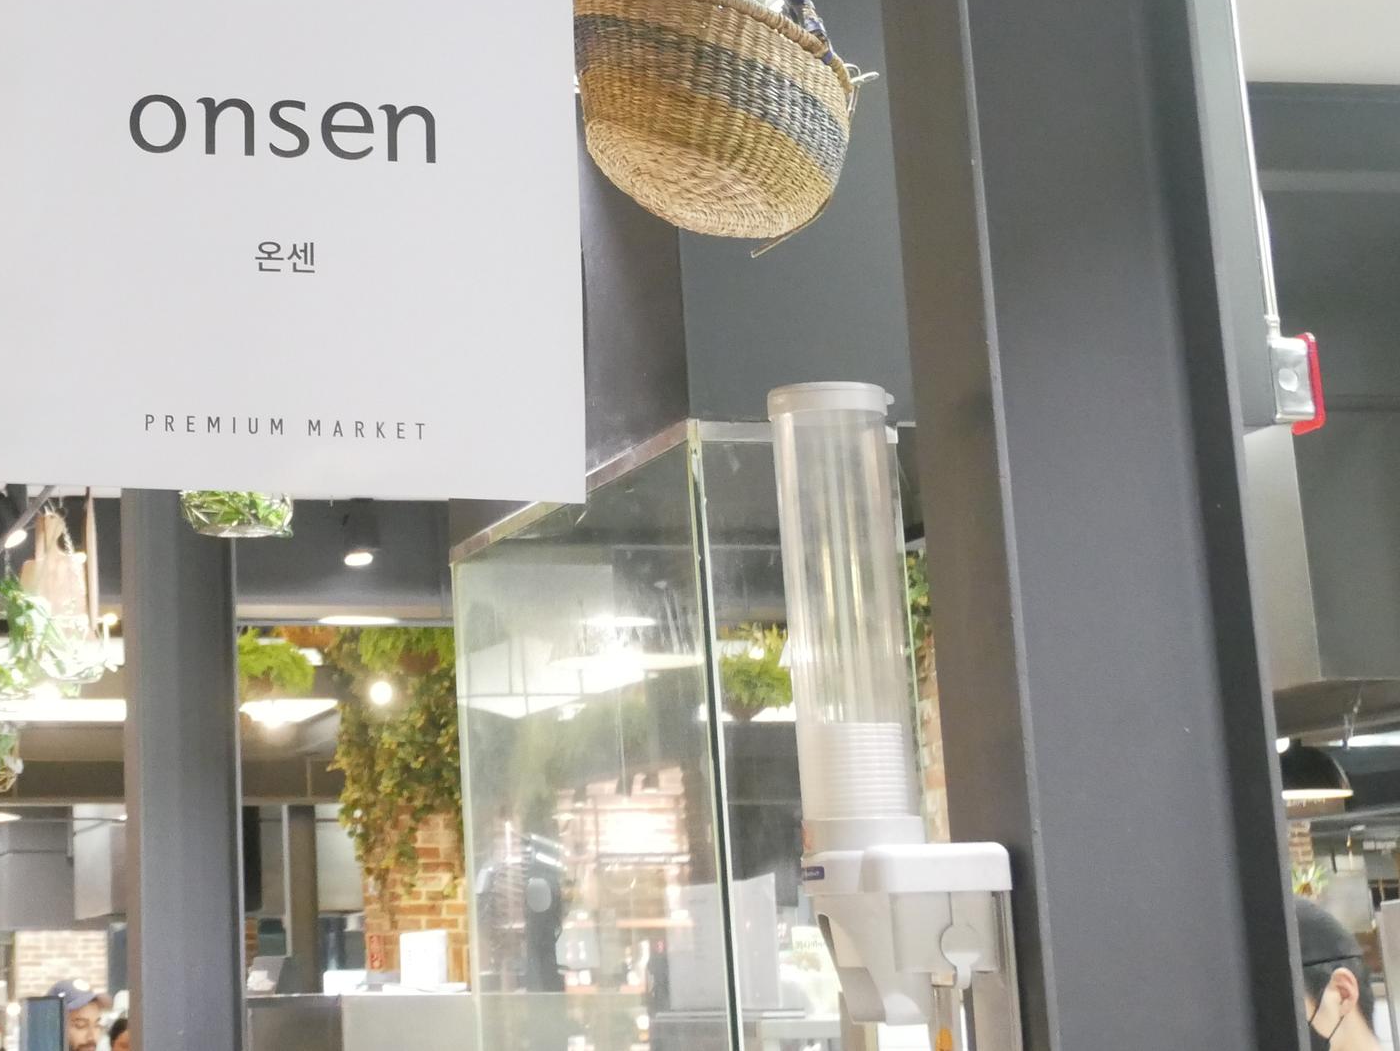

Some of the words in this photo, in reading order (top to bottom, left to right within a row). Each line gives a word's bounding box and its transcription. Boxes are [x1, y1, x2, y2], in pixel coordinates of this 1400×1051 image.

[129, 94, 436, 164] onsen
[255, 241, 315, 274] 온센
[145, 413, 284, 436] PREMIUM
[308, 418, 426, 441] MARKET
